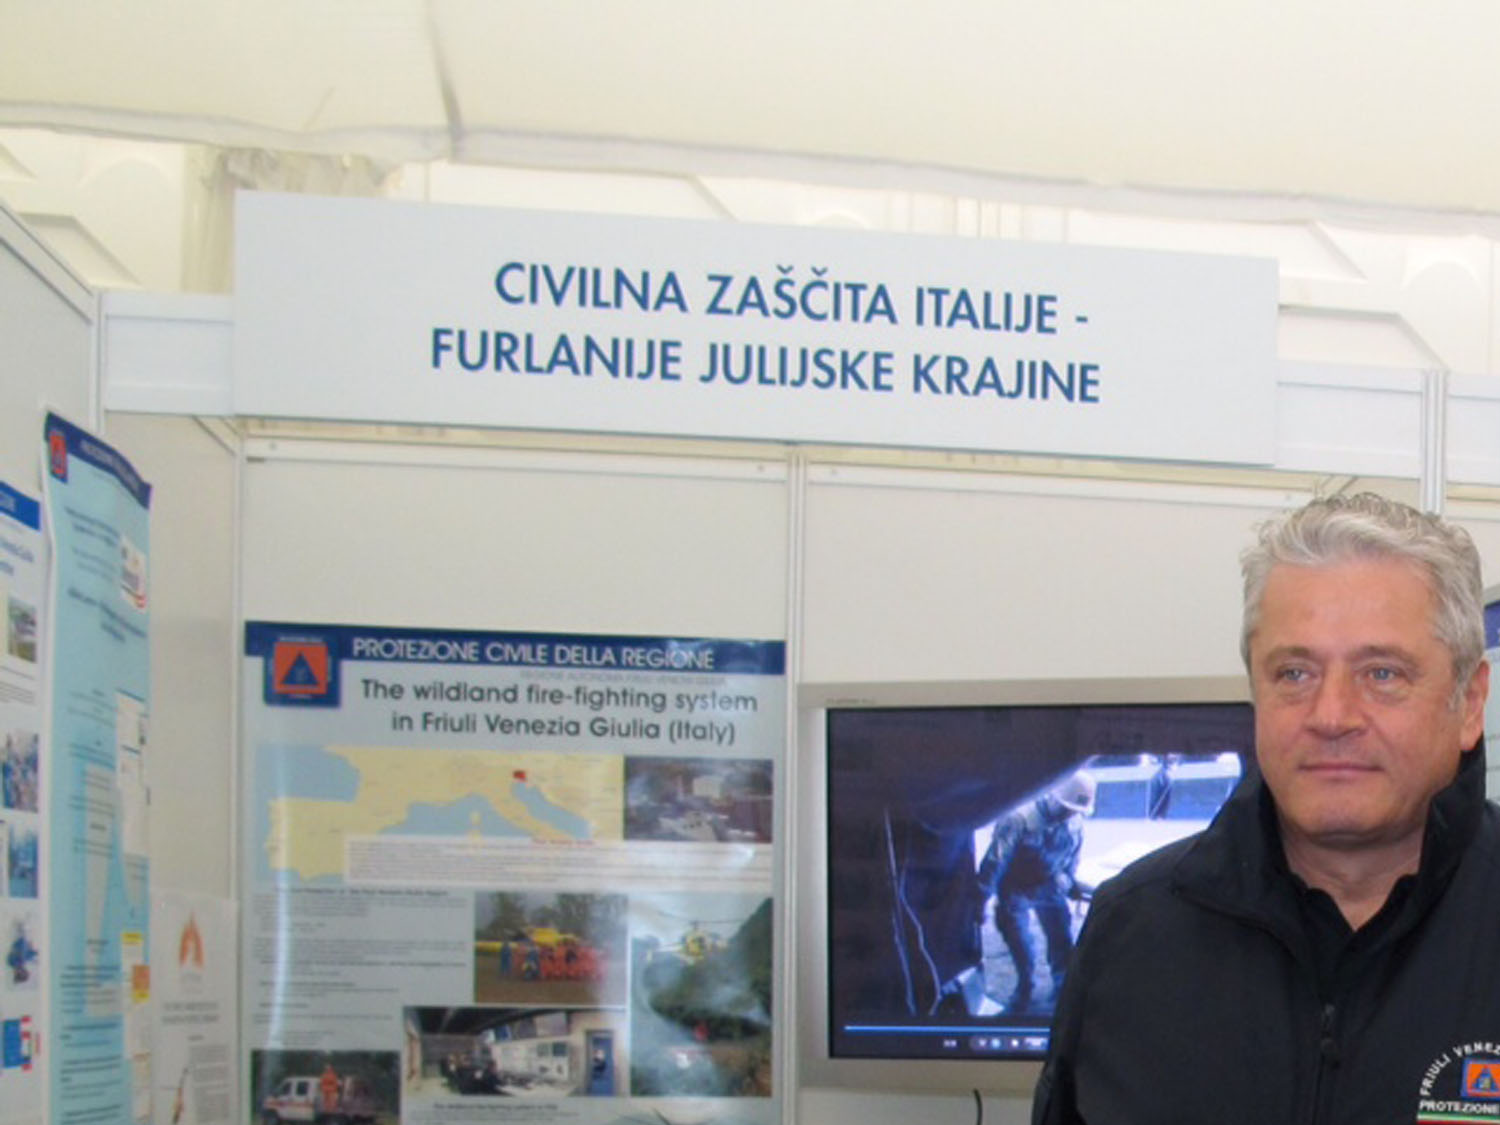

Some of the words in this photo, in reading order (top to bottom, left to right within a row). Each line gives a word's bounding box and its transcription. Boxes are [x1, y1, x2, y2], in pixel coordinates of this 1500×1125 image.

[495, 262, 689, 313] CIVILNA
[706, 265, 898, 325] ZAŠČITA
[915, 286, 1058, 335] ITALIJE
[431, 327, 683, 381] FURLANIJE
[698, 342, 894, 392] JULIJSKE
[912, 353, 1100, 404] KRAJINE
[352, 637, 479, 662] PROTEZIONE
[486, 641, 548, 664] CIVILE
[554, 644, 616, 667] DELLA
[621, 646, 715, 670] REGIONE
[361, 678, 404, 700] The
[413, 681, 518, 704] wildland
[527, 684, 667, 712] fire-fighting
[675, 691, 758, 713] system
[392, 711, 413, 731] in
[422, 711, 477, 733] Friuli
[485, 713, 581, 737] Venezia
[589, 717, 661, 739] Giulia
[668, 719, 736, 745] (Italy)
[1419, 1053, 1453, 1096] FRIULI
[1419, 1100, 1500, 1114] PROTEZIONE
